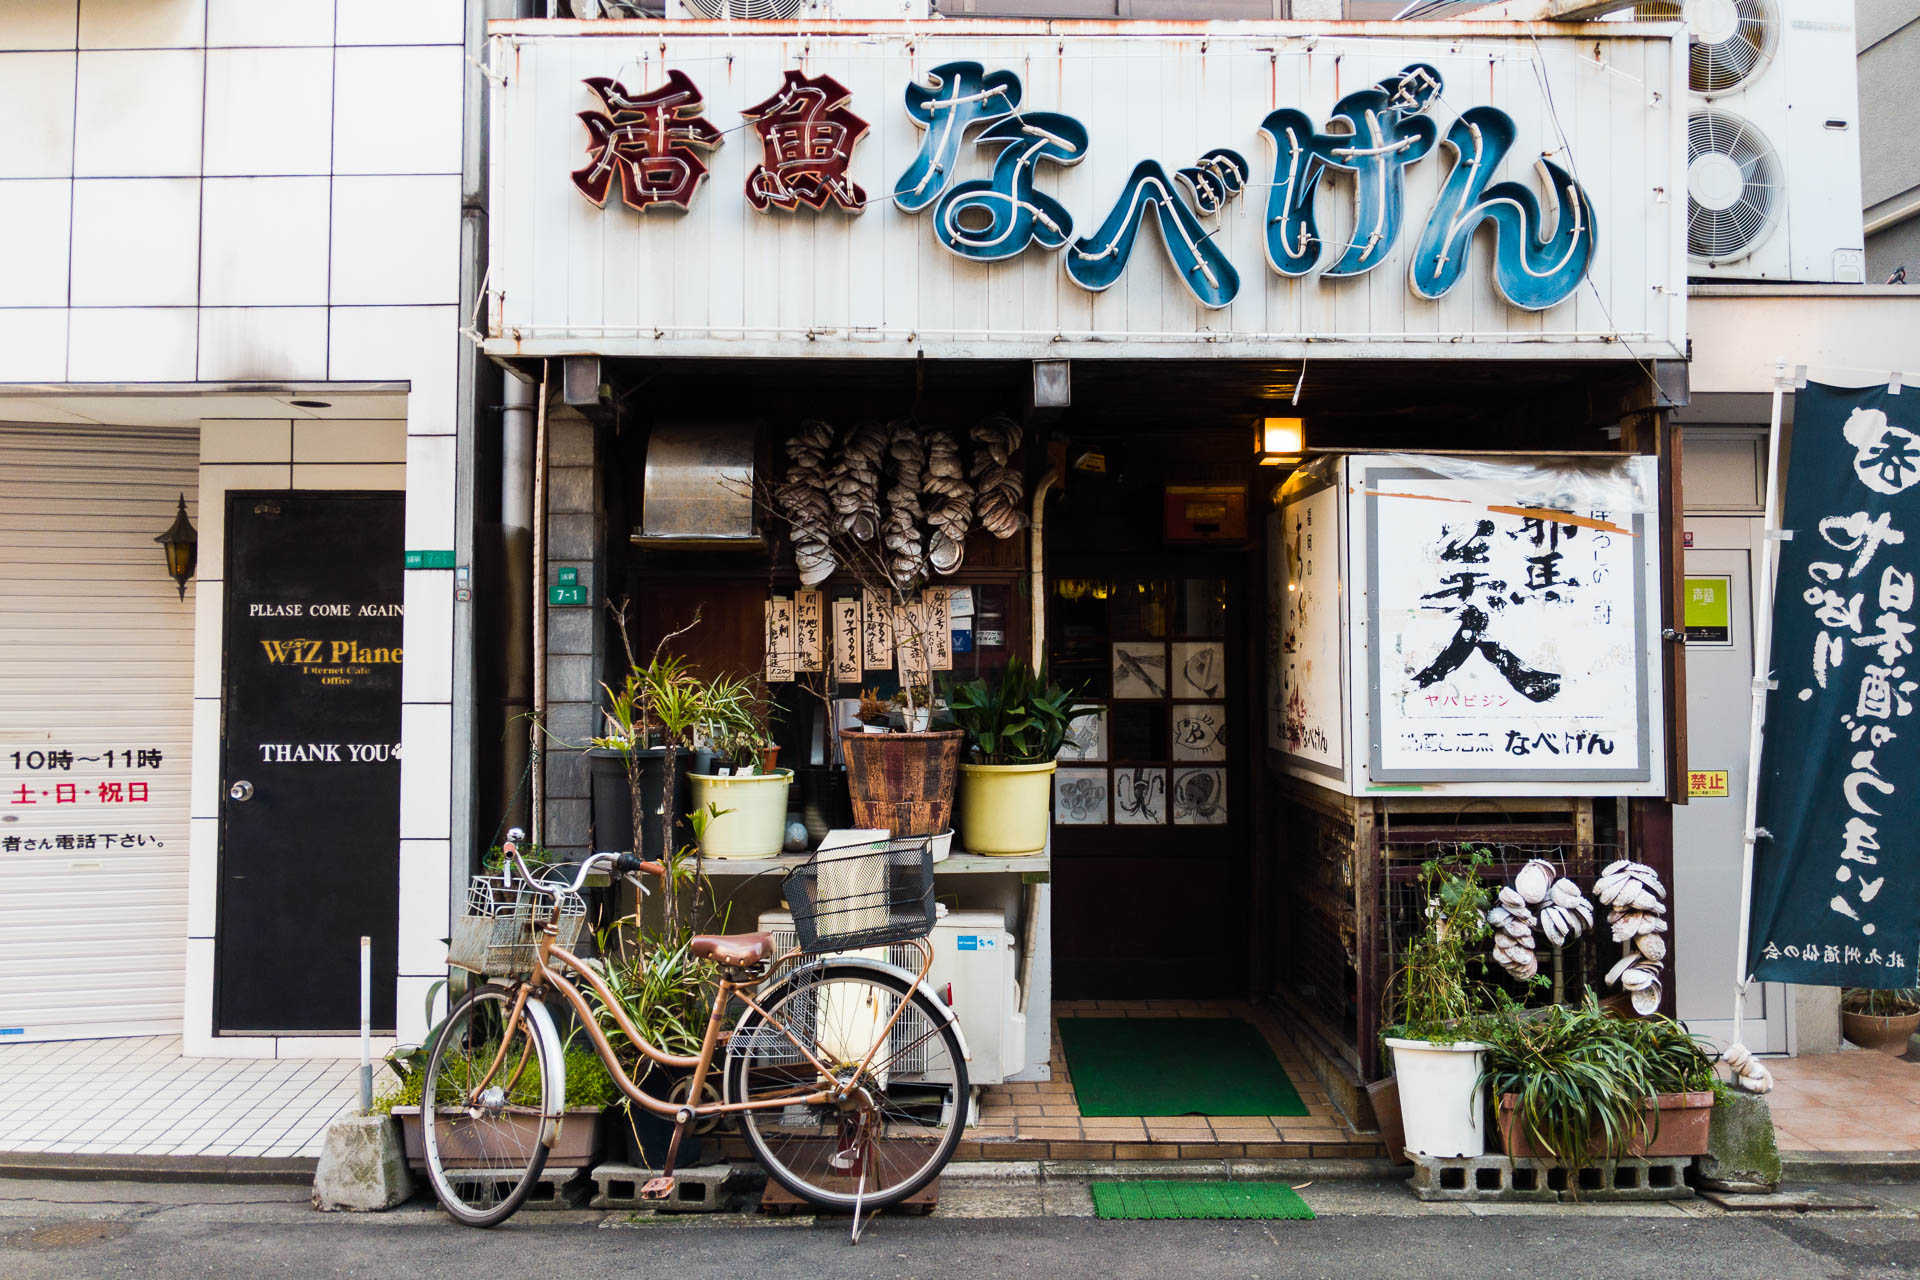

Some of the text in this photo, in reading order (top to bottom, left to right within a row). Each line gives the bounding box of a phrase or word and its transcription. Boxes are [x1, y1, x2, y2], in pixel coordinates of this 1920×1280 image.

[570, 60, 1598, 311] 活魚 なべげん
[556, 589, 578, 601] 7-1
[249, 604, 404, 617] PLEASE COME AGAIN
[330, 640, 404, 664] Plane
[839, 662, 857, 674] 580
[321, 677, 353, 686] Office
[1424, 695, 1513, 708] ヤバビジン
[1504, 729, 1614, 756] なべげん
[259, 744, 390, 762] THANK YOU
[1690, 773, 1724, 790] 禁止
